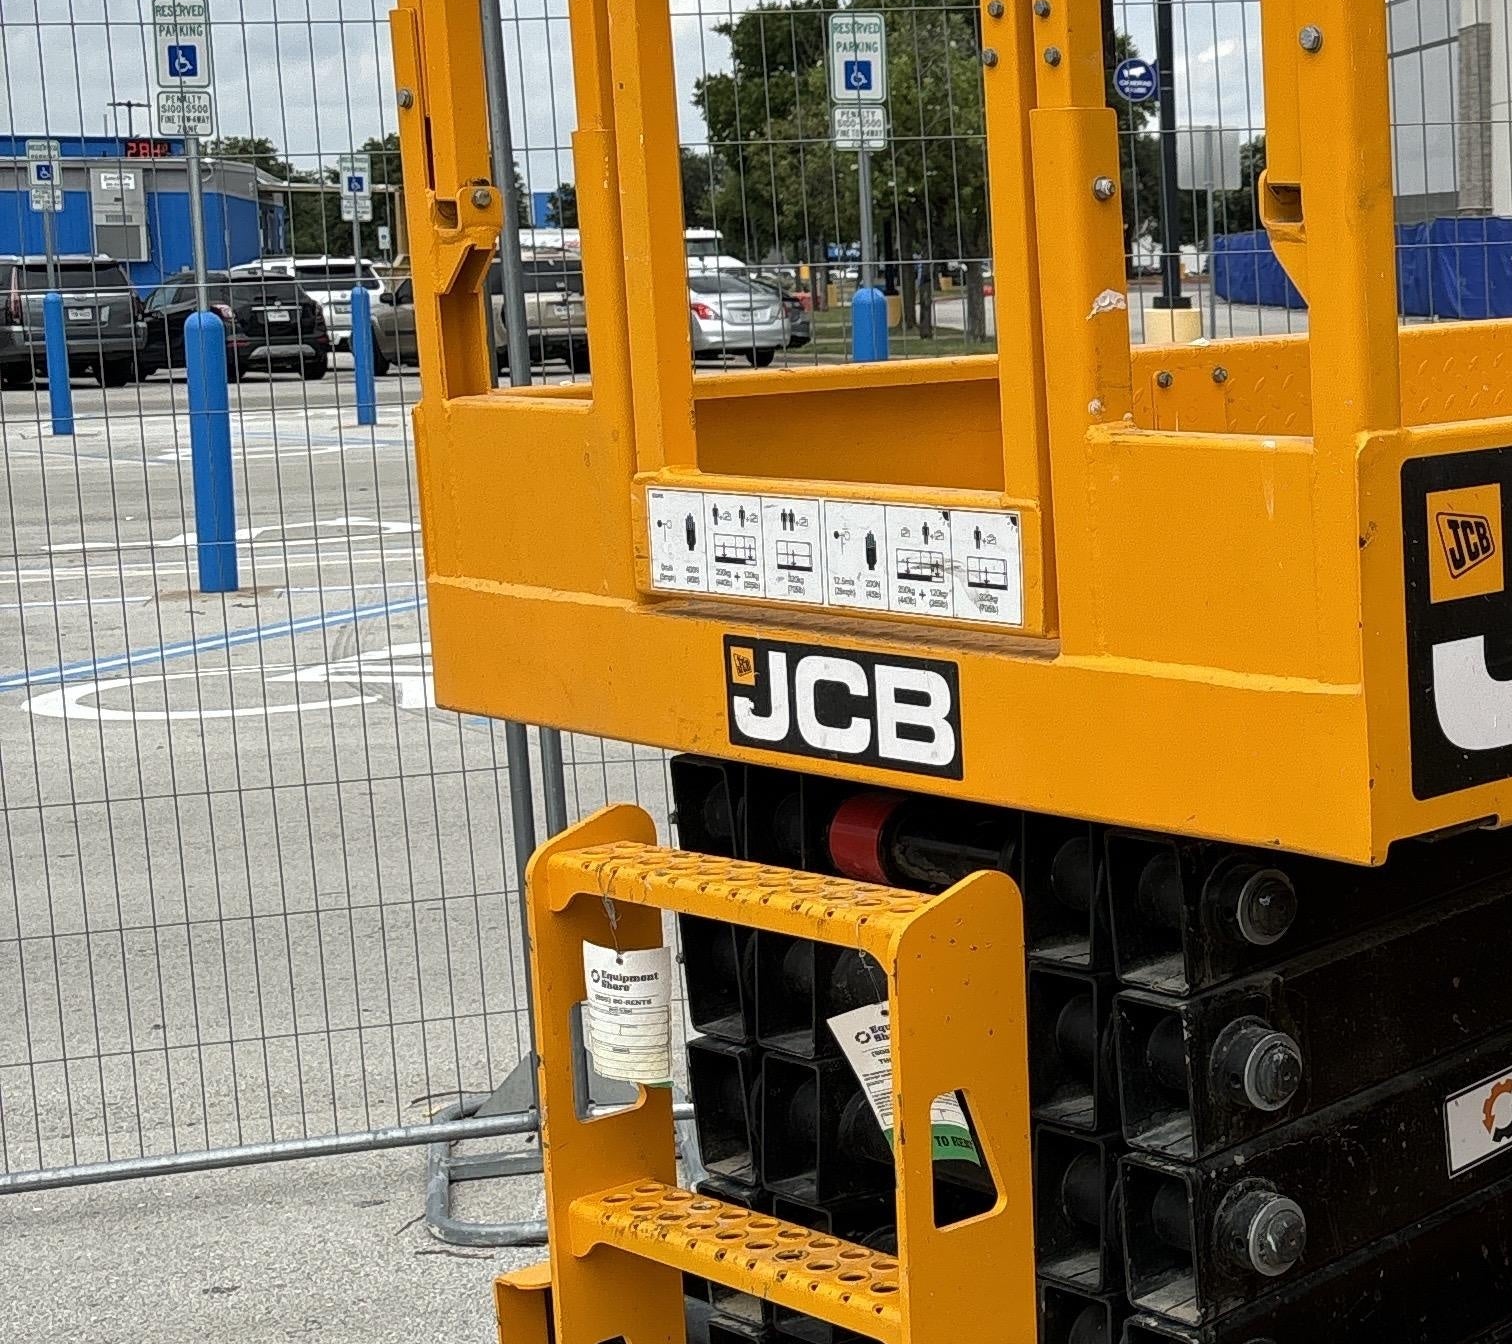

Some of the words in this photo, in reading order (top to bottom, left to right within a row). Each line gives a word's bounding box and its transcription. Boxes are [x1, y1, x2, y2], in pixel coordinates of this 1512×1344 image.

[155, 5, 204, 18] RESERVED
[158, 24, 204, 37] PARKING
[832, 22, 880, 34] RESERVED
[836, 41, 879, 53] PARKING
[1446, 518, 1492, 571] JCB
[733, 650, 956, 766] JCB
[601, 969, 660, 984] Equipment
[601, 979, 630, 992] Share
[934, 1135, 950, 1147] TO
